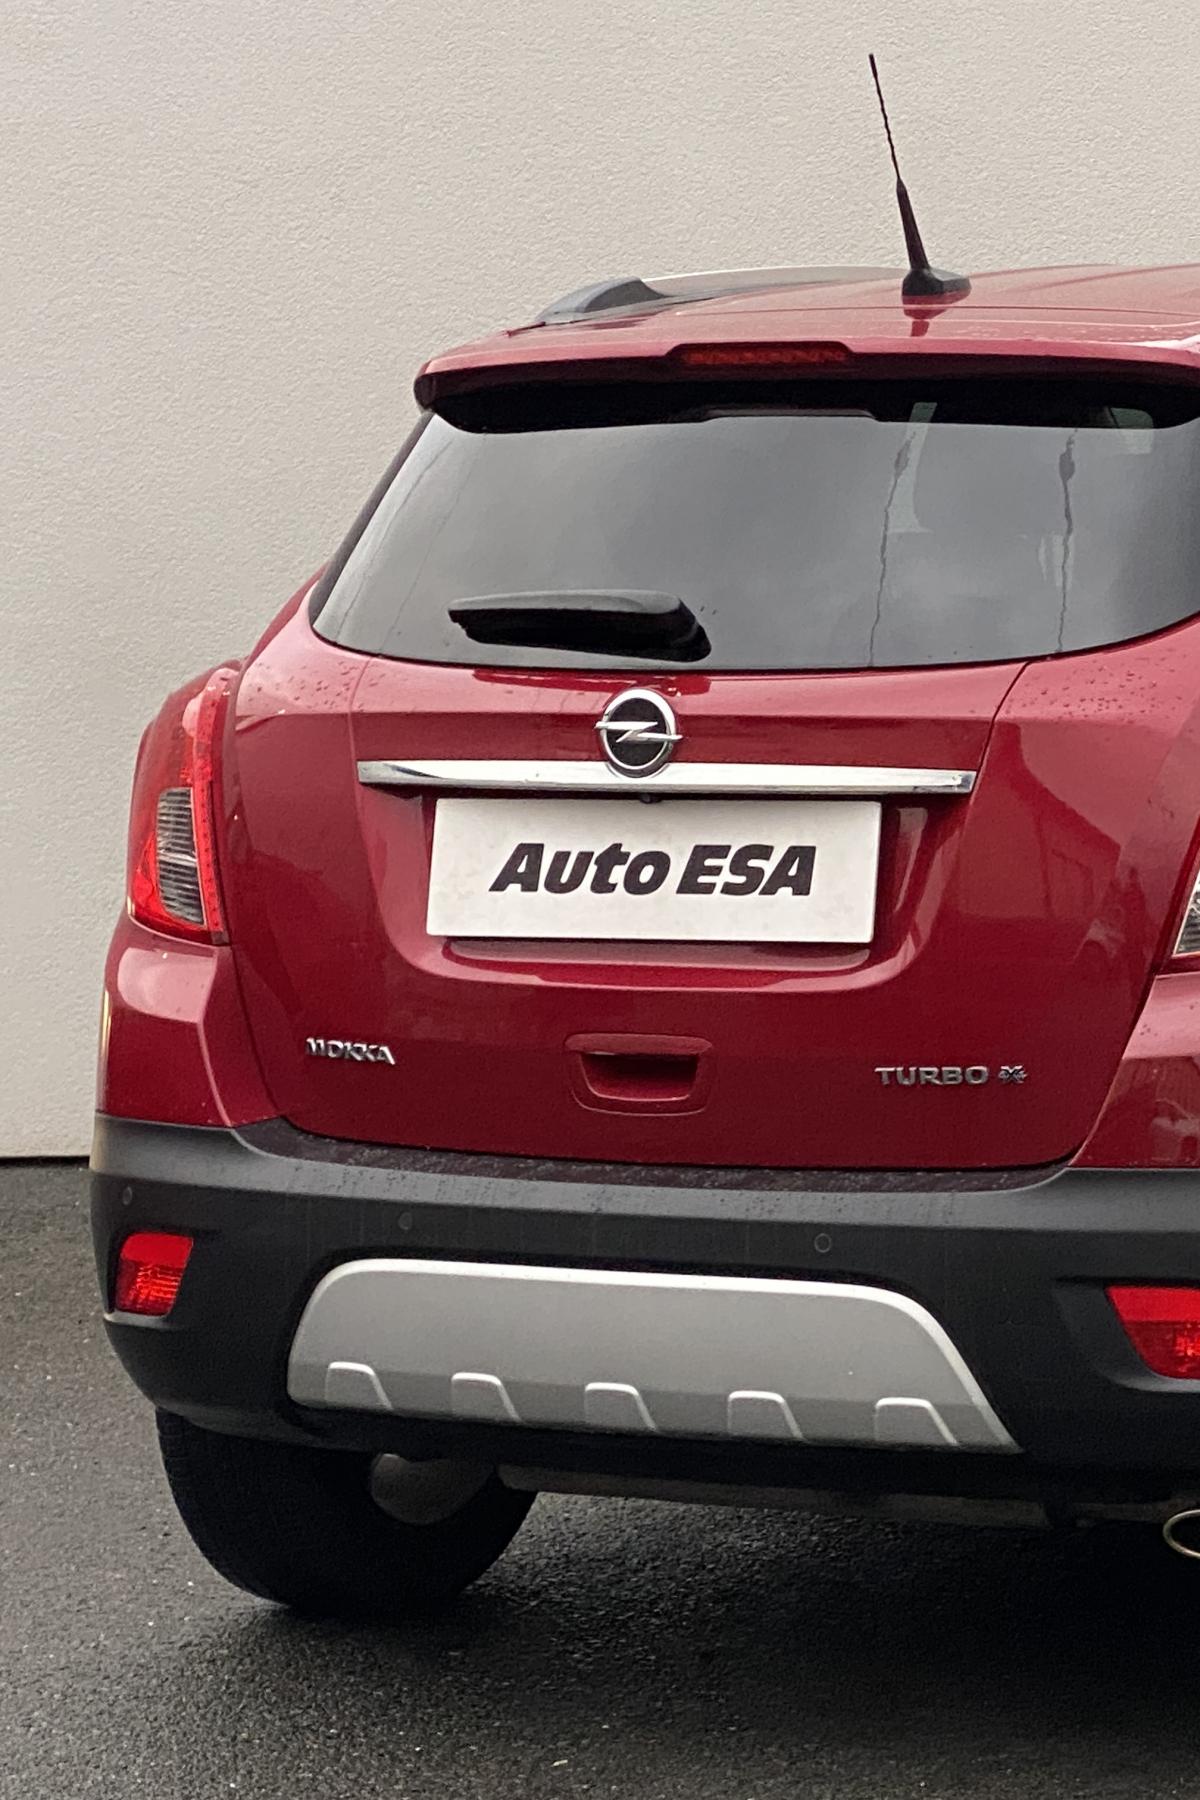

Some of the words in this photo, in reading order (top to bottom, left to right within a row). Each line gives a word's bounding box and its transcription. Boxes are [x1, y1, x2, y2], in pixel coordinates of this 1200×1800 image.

[488, 842, 671, 895] Auto
[676, 844, 816, 896] ESA
[874, 1065, 989, 1085] TURBO
